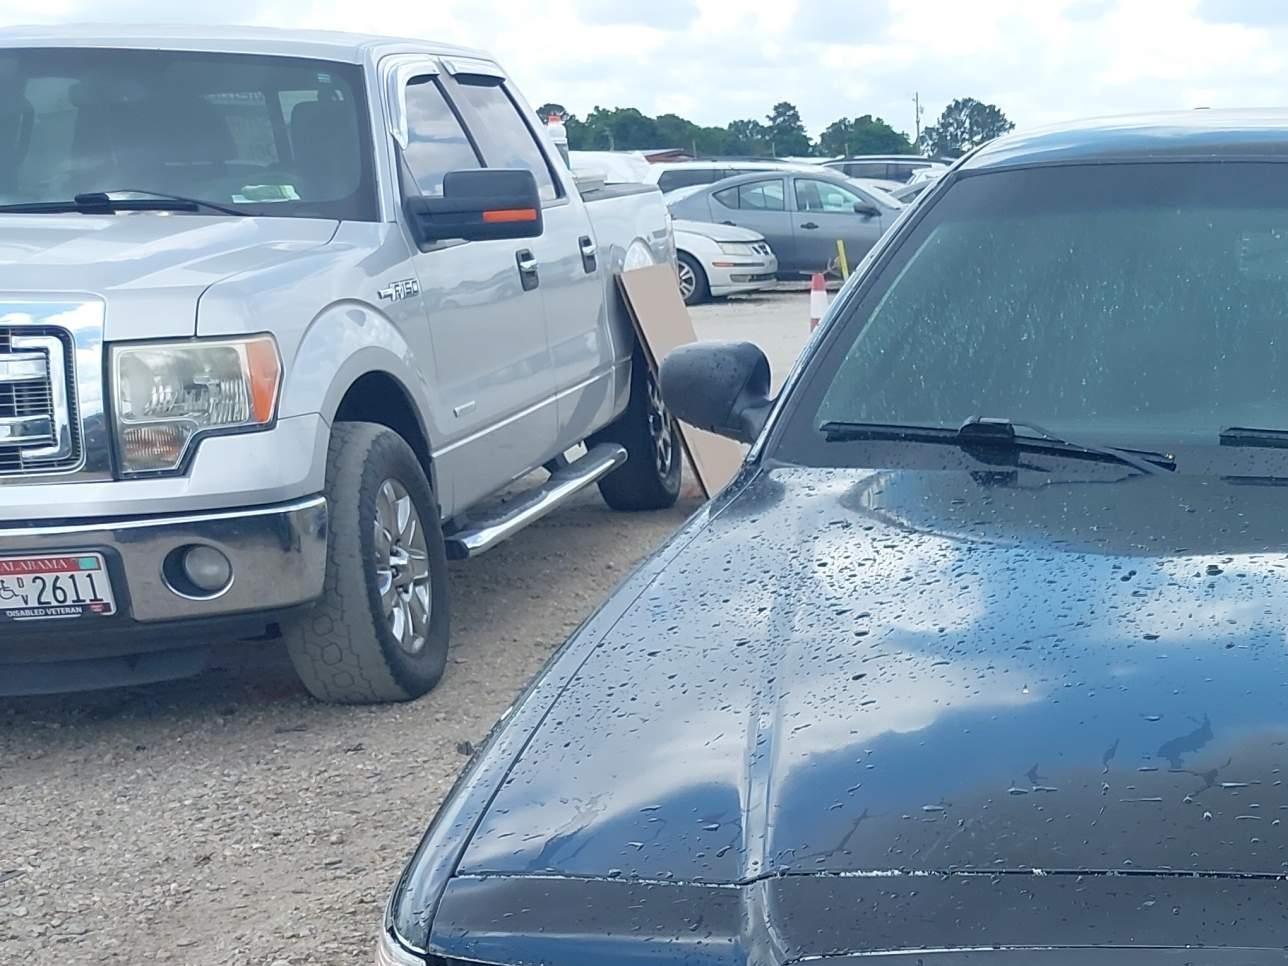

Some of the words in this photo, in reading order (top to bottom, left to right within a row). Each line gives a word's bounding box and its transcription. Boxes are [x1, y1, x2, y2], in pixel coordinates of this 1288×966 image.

[32, 573, 104, 605] 2611
[20, 595, 28, 605] V
[6, 608, 45, 617] DISABLED
[46, 606, 83, 615] VETERAN
